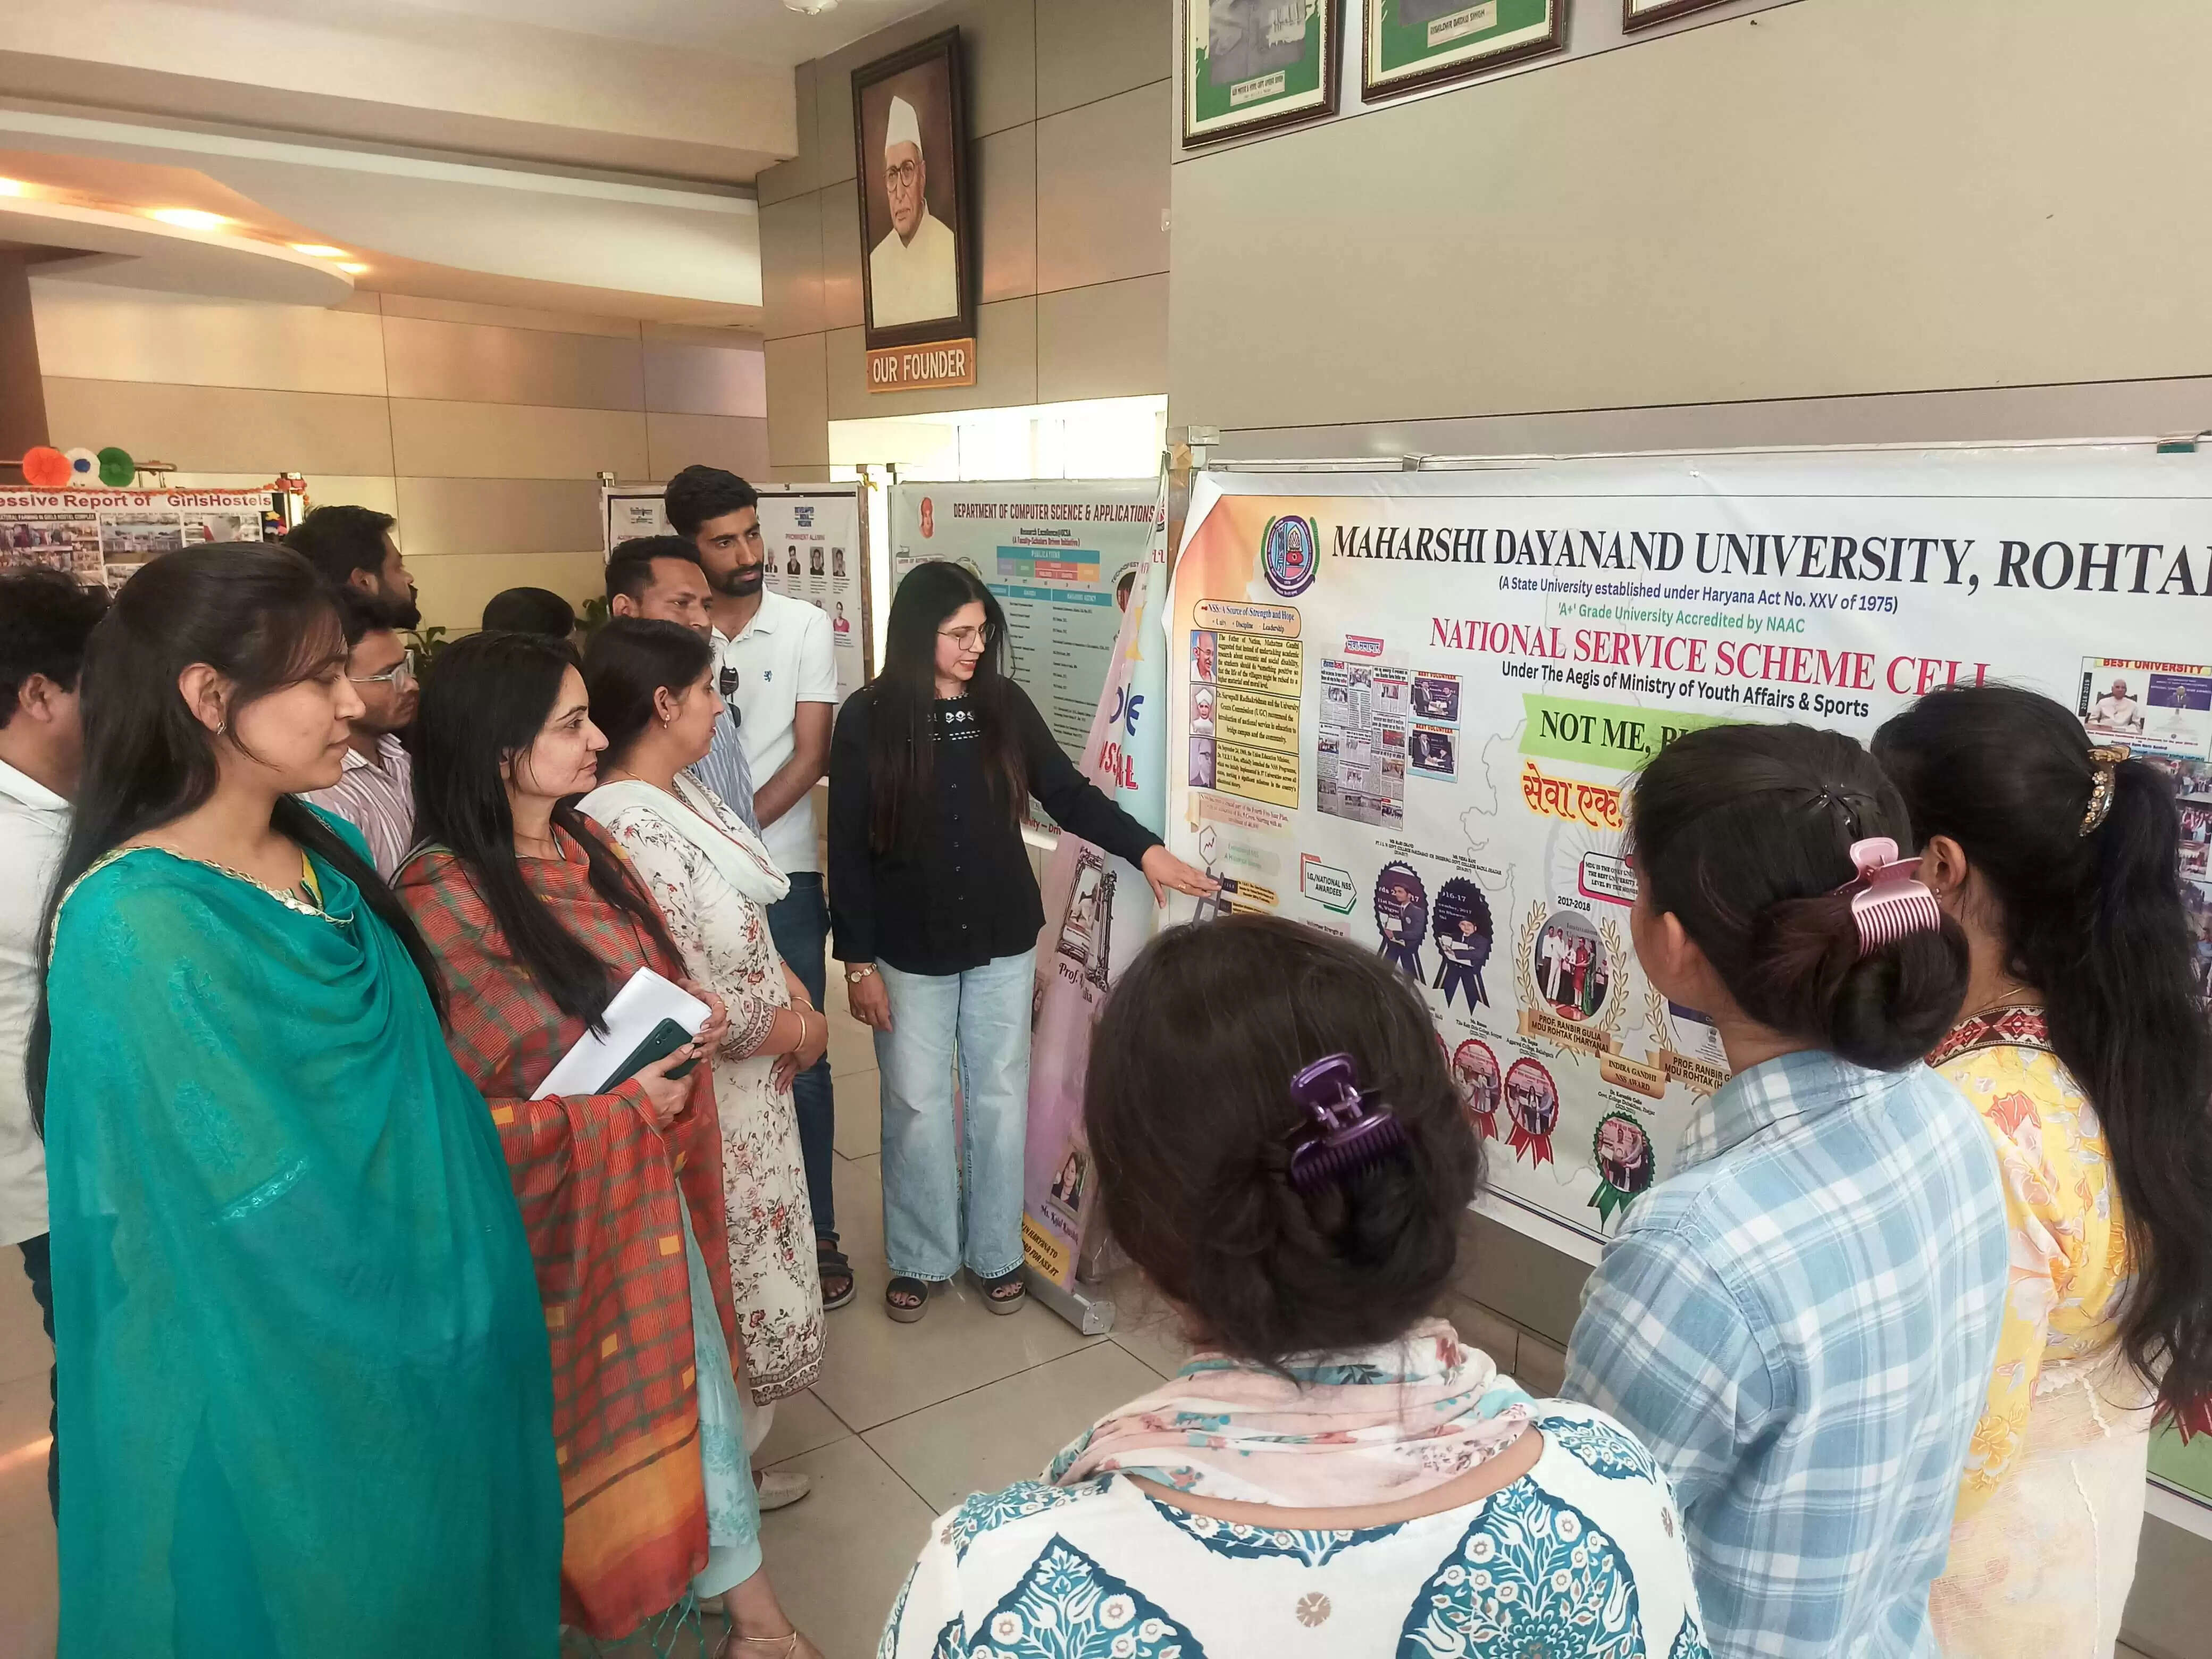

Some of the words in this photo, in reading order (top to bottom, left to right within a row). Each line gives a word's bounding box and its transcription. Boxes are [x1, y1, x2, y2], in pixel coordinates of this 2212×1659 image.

[1470, 10, 1485, 21] SINGH
[873, 357, 898, 383] OUR
[903, 349, 965, 381] FOUNDER
[64, 495, 128, 509] Report
[133, 495, 152, 507] of
[953, 502, 997, 519] DEPARTMENT
[999, 503, 1009, 519] OF
[1010, 504, 1049, 520] COMPUTER
[1051, 504, 1083, 521] SCIENCE
[1085, 505, 1091, 521] &
[1093, 504, 1154, 523] APPLICATIONS
[1332, 525, 1488, 563] MAHARSHI
[1494, 529, 1683, 571] DAYANAND
[1696, 533, 1979, 596] UNIVERSITY,
[1993, 540, 2212, 597] ROHTA
[1499, 575, 1510, 591] (A
[1511, 577, 1538, 591] State
[1540, 578, 1593, 598] University
[1595, 582, 1661, 598] established
[1664, 584, 1699, 601] under
[1703, 586, 1754, 606] Haryana
[1757, 589, 1781, 606] Act
[1784, 591, 1806, 607] No.
[1809, 592, 1838, 609] XXV
[1841, 594, 1857, 610] of
[1858, 595, 1898, 615] 1975)
[1227, 606, 1242, 615] Source
[1250, 607, 1271, 619] Strength
[1272, 610, 1281, 619] and
[1282, 610, 1294, 623] Hope
[1559, 602, 1576, 616] 'A+'
[1579, 604, 1612, 619] Grade
[1615, 606, 1674, 627] University
[1676, 610, 1743, 630] Accredited
[1747, 614, 1763, 634] by
[1766, 616, 1805, 633] NAAC
[1236, 621, 1253, 630] Discipline
[1263, 623, 1284, 633] Leadership
[1429, 617, 1566, 659] NATIONAL
[1574, 629, 1708, 673] SERVICE
[1715, 640, 1875, 690] SCHEME
[2102, 659, 2132, 668] BEST
[2134, 660, 2204, 674] UNIVERSITY
[1502, 661, 1538, 679] Under
[1541, 665, 1563, 683] The
[1565, 668, 1599, 690] Aegis
[1603, 672, 1618, 688] of
[1620, 673, 1675, 699] Ministry
[1679, 680, 1694, 698] of
[1698, 681, 1739, 703] Youth
[1743, 686, 1795, 709] Affairs
[1798, 692, 1809, 710] &
[1813, 693, 1869, 717] Sports
[1427, 725, 1453, 734] VOLUNTEER
[1539, 710, 1596, 745] NOT
[1601, 718, 1652, 759] ME,
[1522, 761, 1576, 819] सेवा
[1577, 785, 1623, 827] एक,
[1315, 884, 1342, 897] AWARDEES
[1342, 881, 1352, 891] NSS
[1557, 895, 1591, 912] 2017-2018
[1059, 962, 1078, 984] Prof.
[1531, 1021, 1546, 1031] MDU
[1547, 1026, 1572, 1041] ROHTAK
[1573, 1033, 1608, 1053] (HARYANA)
[1539, 1015, 1556, 1027] PROF.
[1557, 1021, 1581, 1035] RANBIR
[1582, 1028, 1601, 1042] GULIA
[1608, 1060, 1630, 1074] INDIRA
[1631, 1068, 1656, 1082] GANDHI
[1665, 1063, 1682, 1075] MDU
[1683, 1069, 1713, 1087] ROHTAK
[1673, 1057, 1694, 1070] PROF.
[1695, 1064, 1722, 1081] RANBIR
[1629, 1077, 1650, 1092] AWARD
[1050, 1249, 1058, 1259] TO
[1049, 1267, 1059, 1276] AT
